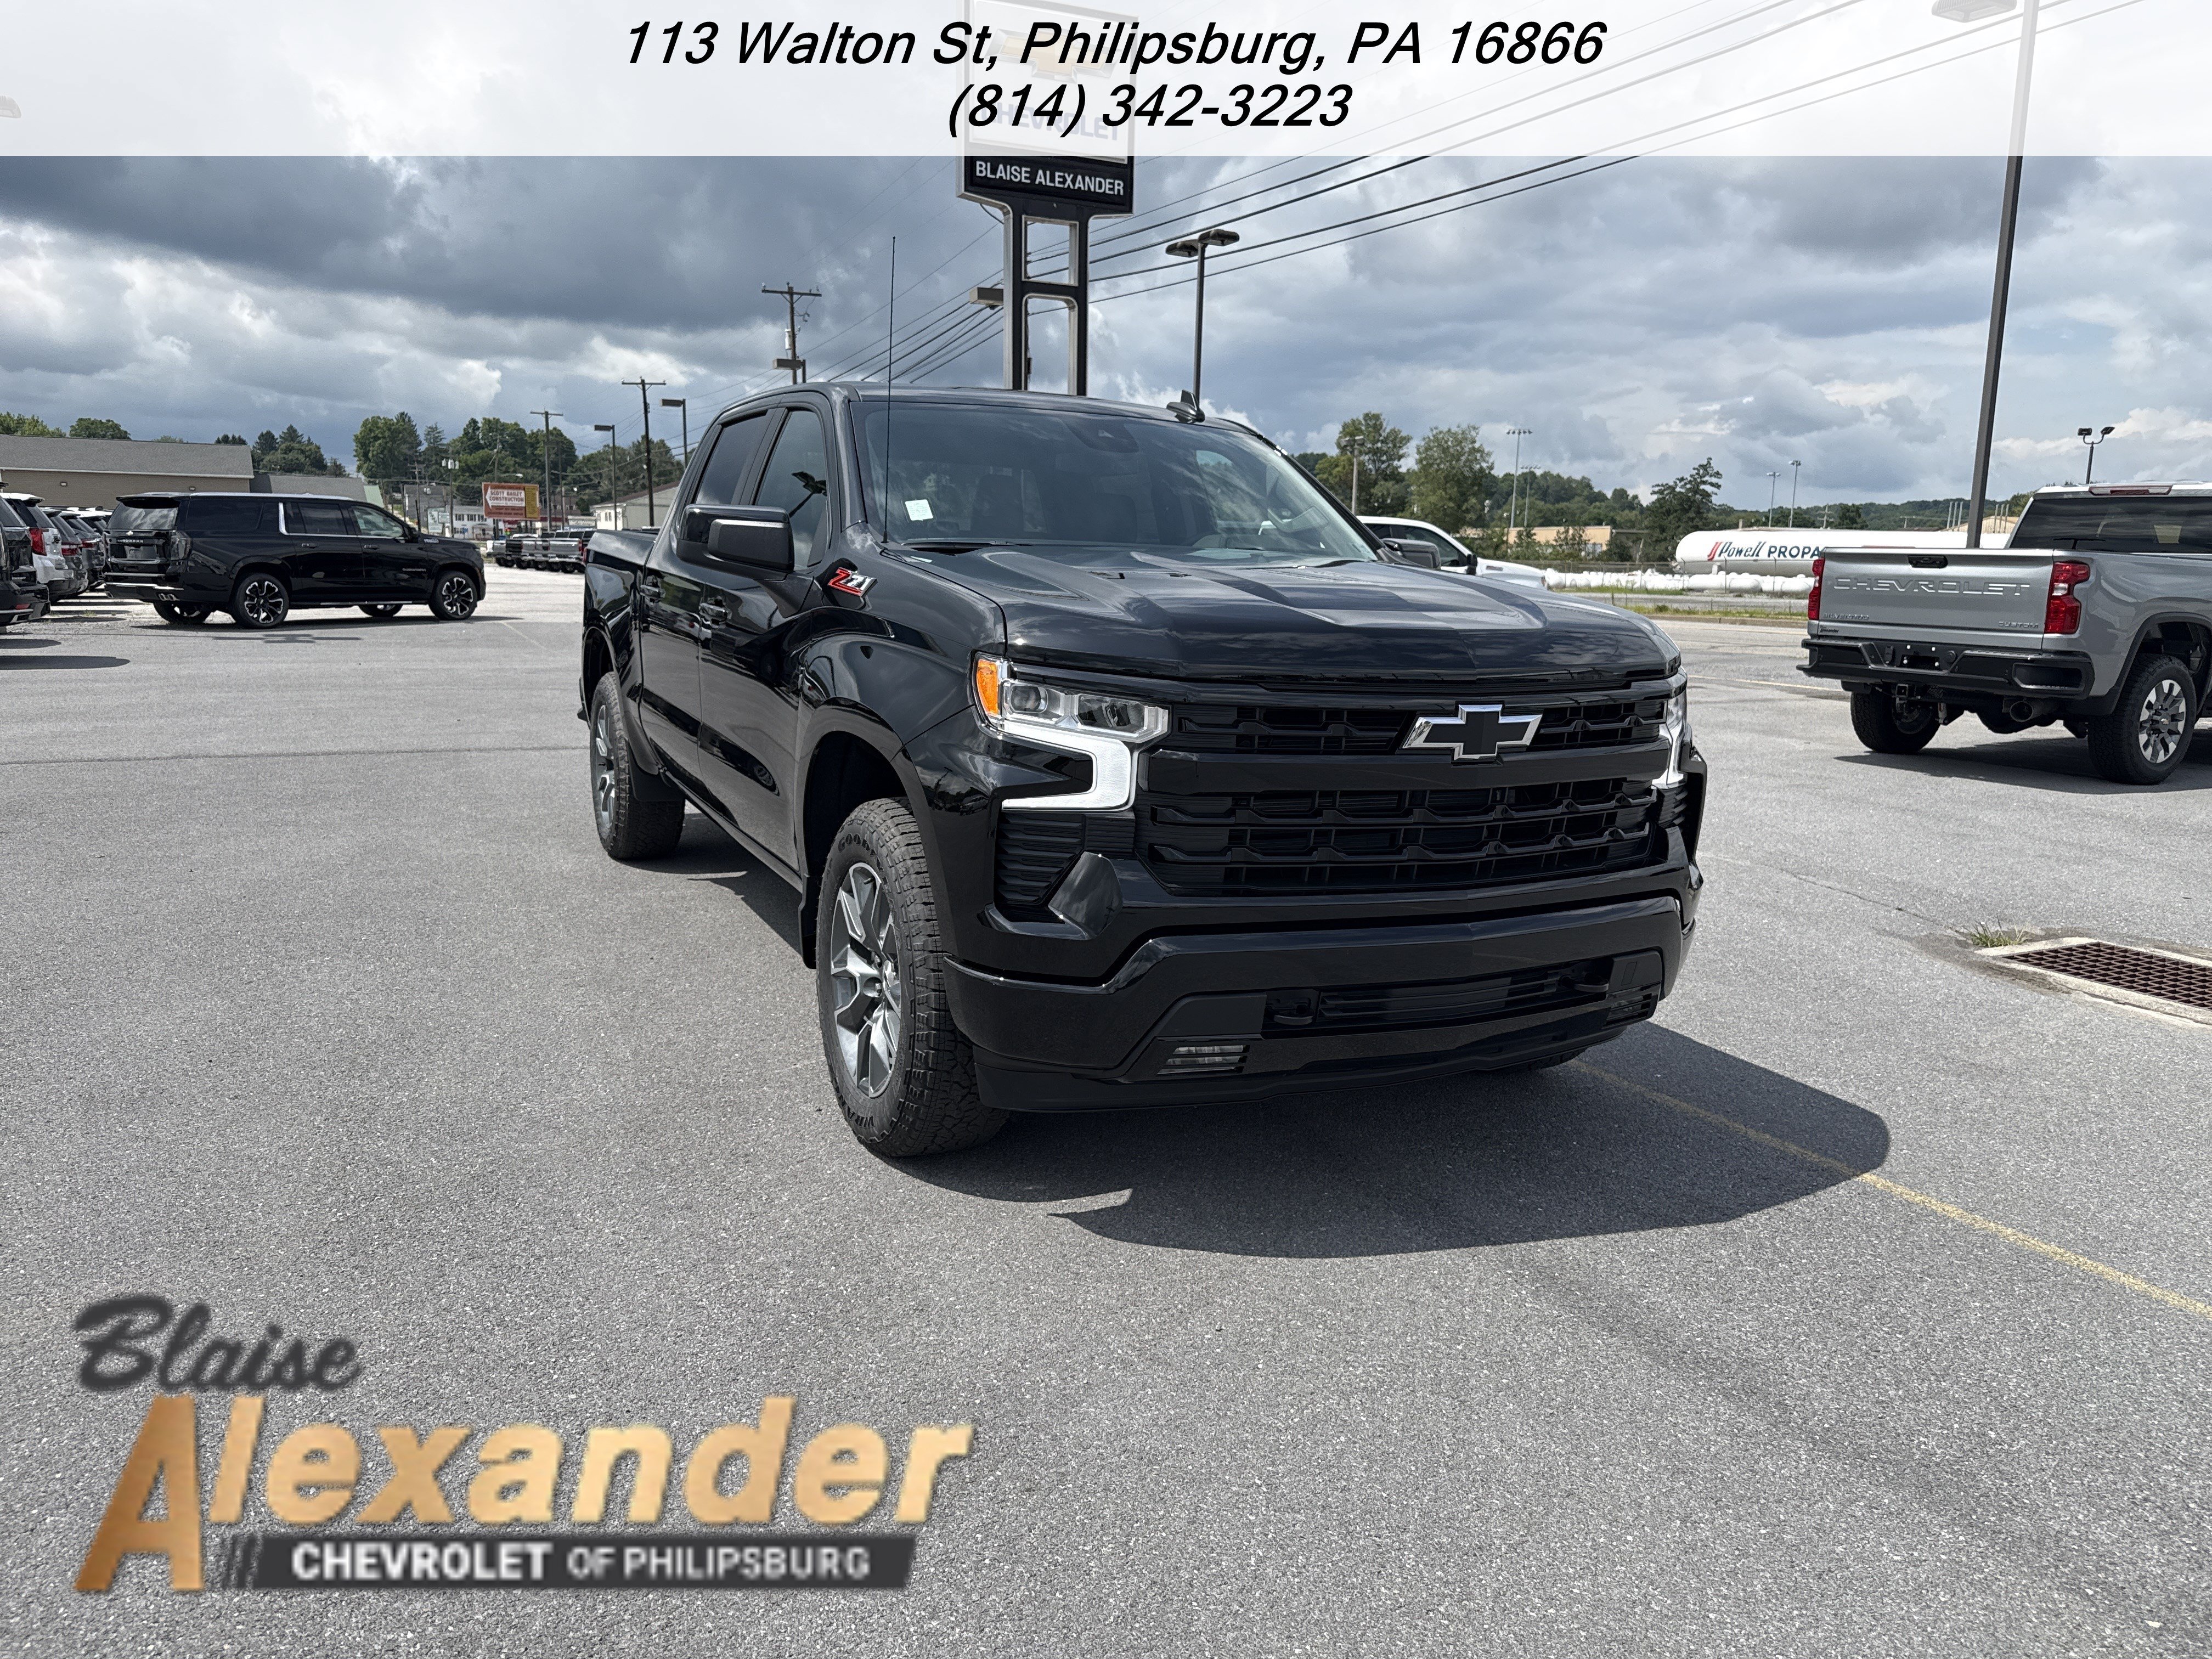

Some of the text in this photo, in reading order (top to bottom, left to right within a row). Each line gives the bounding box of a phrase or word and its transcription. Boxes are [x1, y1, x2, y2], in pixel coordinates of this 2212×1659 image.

[975, 161, 1124, 196] BLAISE ALEXANDER
[1718, 541, 1767, 558] Powell
[828, 566, 878, 597] Z71
[1833, 577, 2030, 596] CHEVROLET
[1998, 620, 2039, 629] CUSTOM
